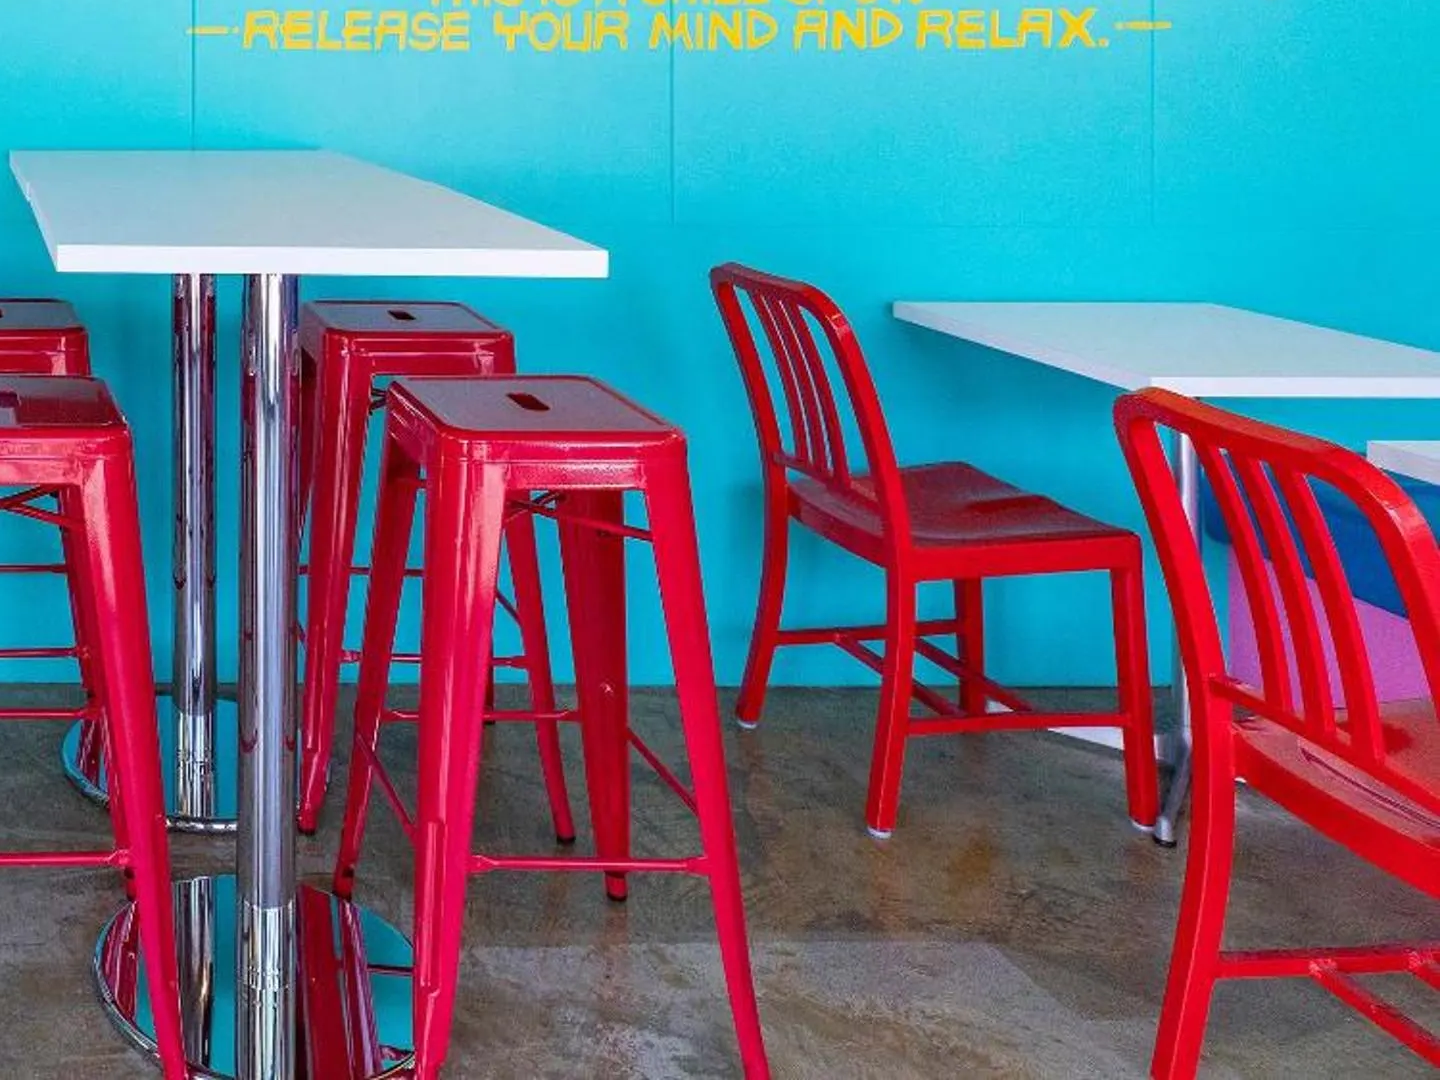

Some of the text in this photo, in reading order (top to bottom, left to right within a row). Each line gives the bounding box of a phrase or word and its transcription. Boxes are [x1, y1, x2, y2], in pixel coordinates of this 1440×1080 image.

[242, 8, 1108, 52] RELEASE YOUR MIND AND RELAX.
